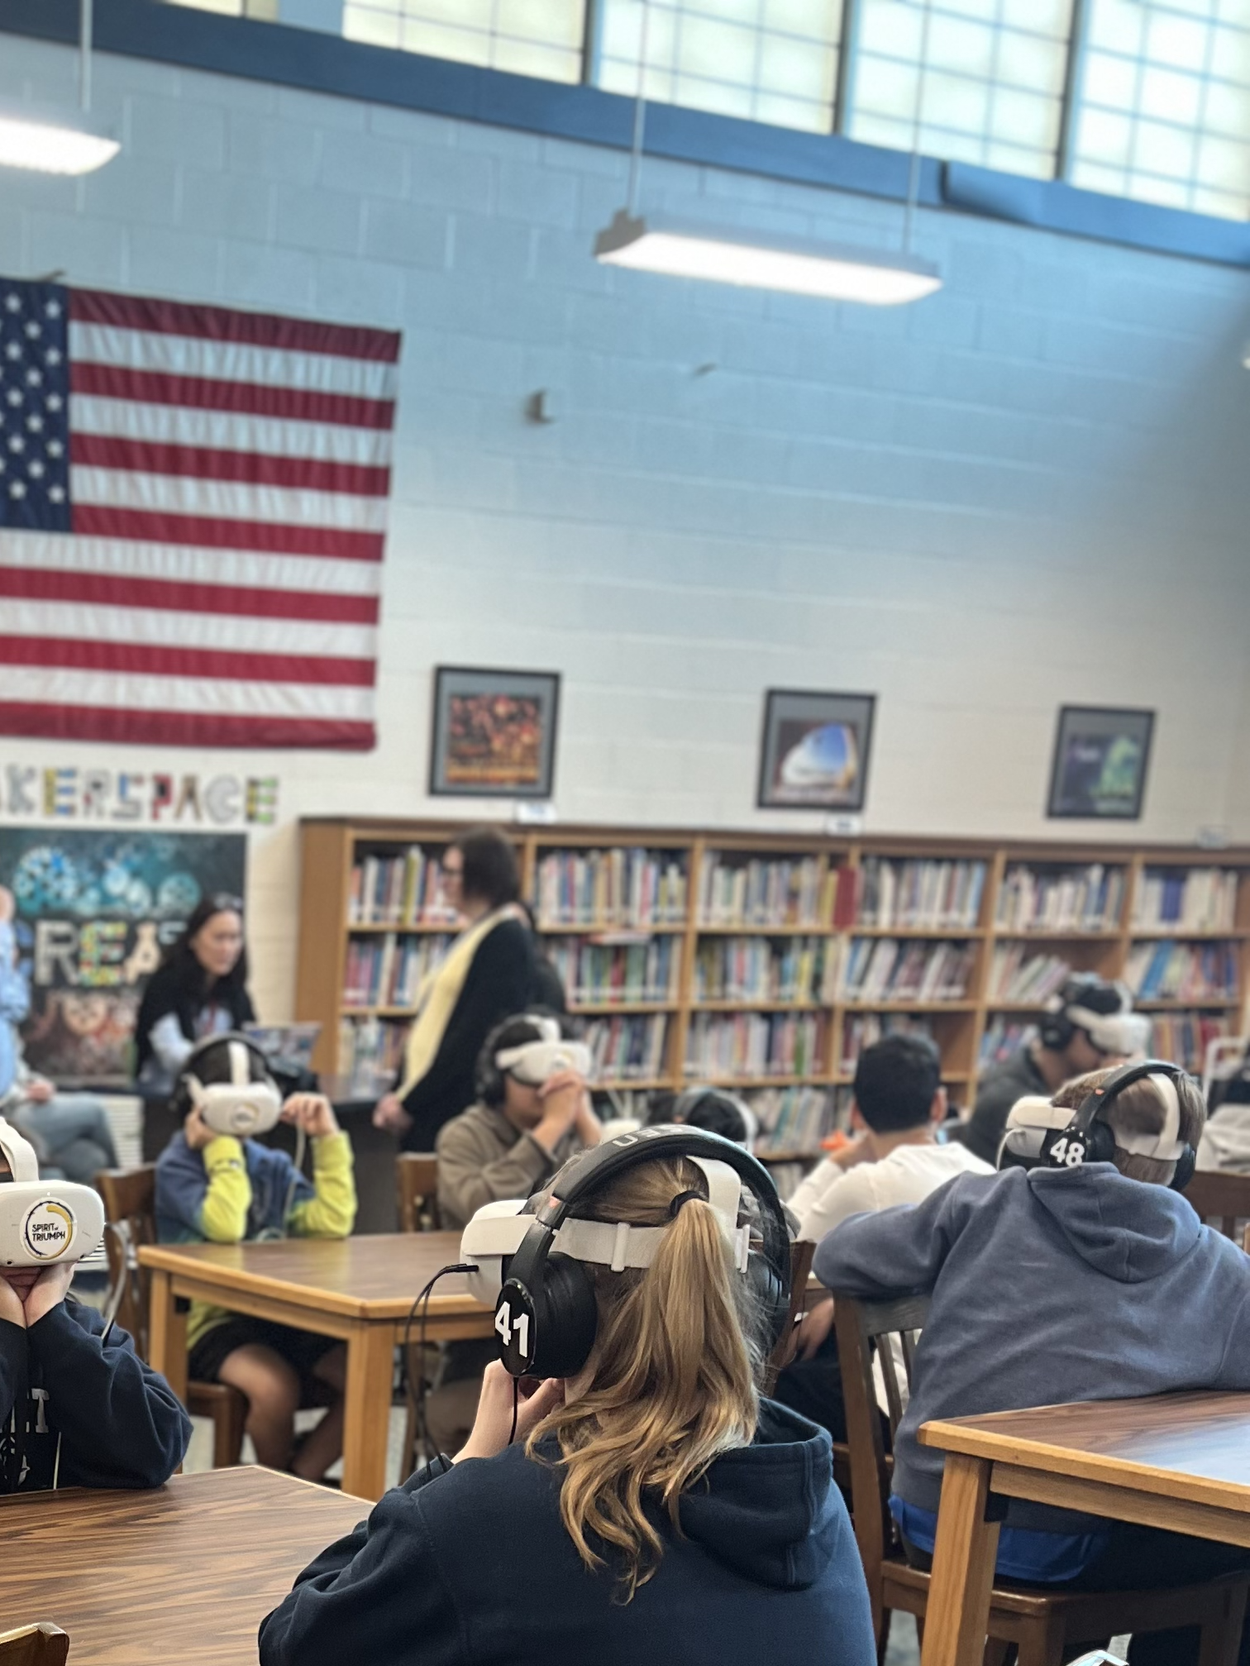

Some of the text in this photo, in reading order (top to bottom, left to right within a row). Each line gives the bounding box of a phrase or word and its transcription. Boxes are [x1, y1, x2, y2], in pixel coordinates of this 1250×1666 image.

[1049, 1137, 1085, 1168] 48
[32, 1222, 55, 1233] SPIRIT
[32, 1231, 66, 1242] TRIUMPH
[494, 1301, 530, 1358] 41
